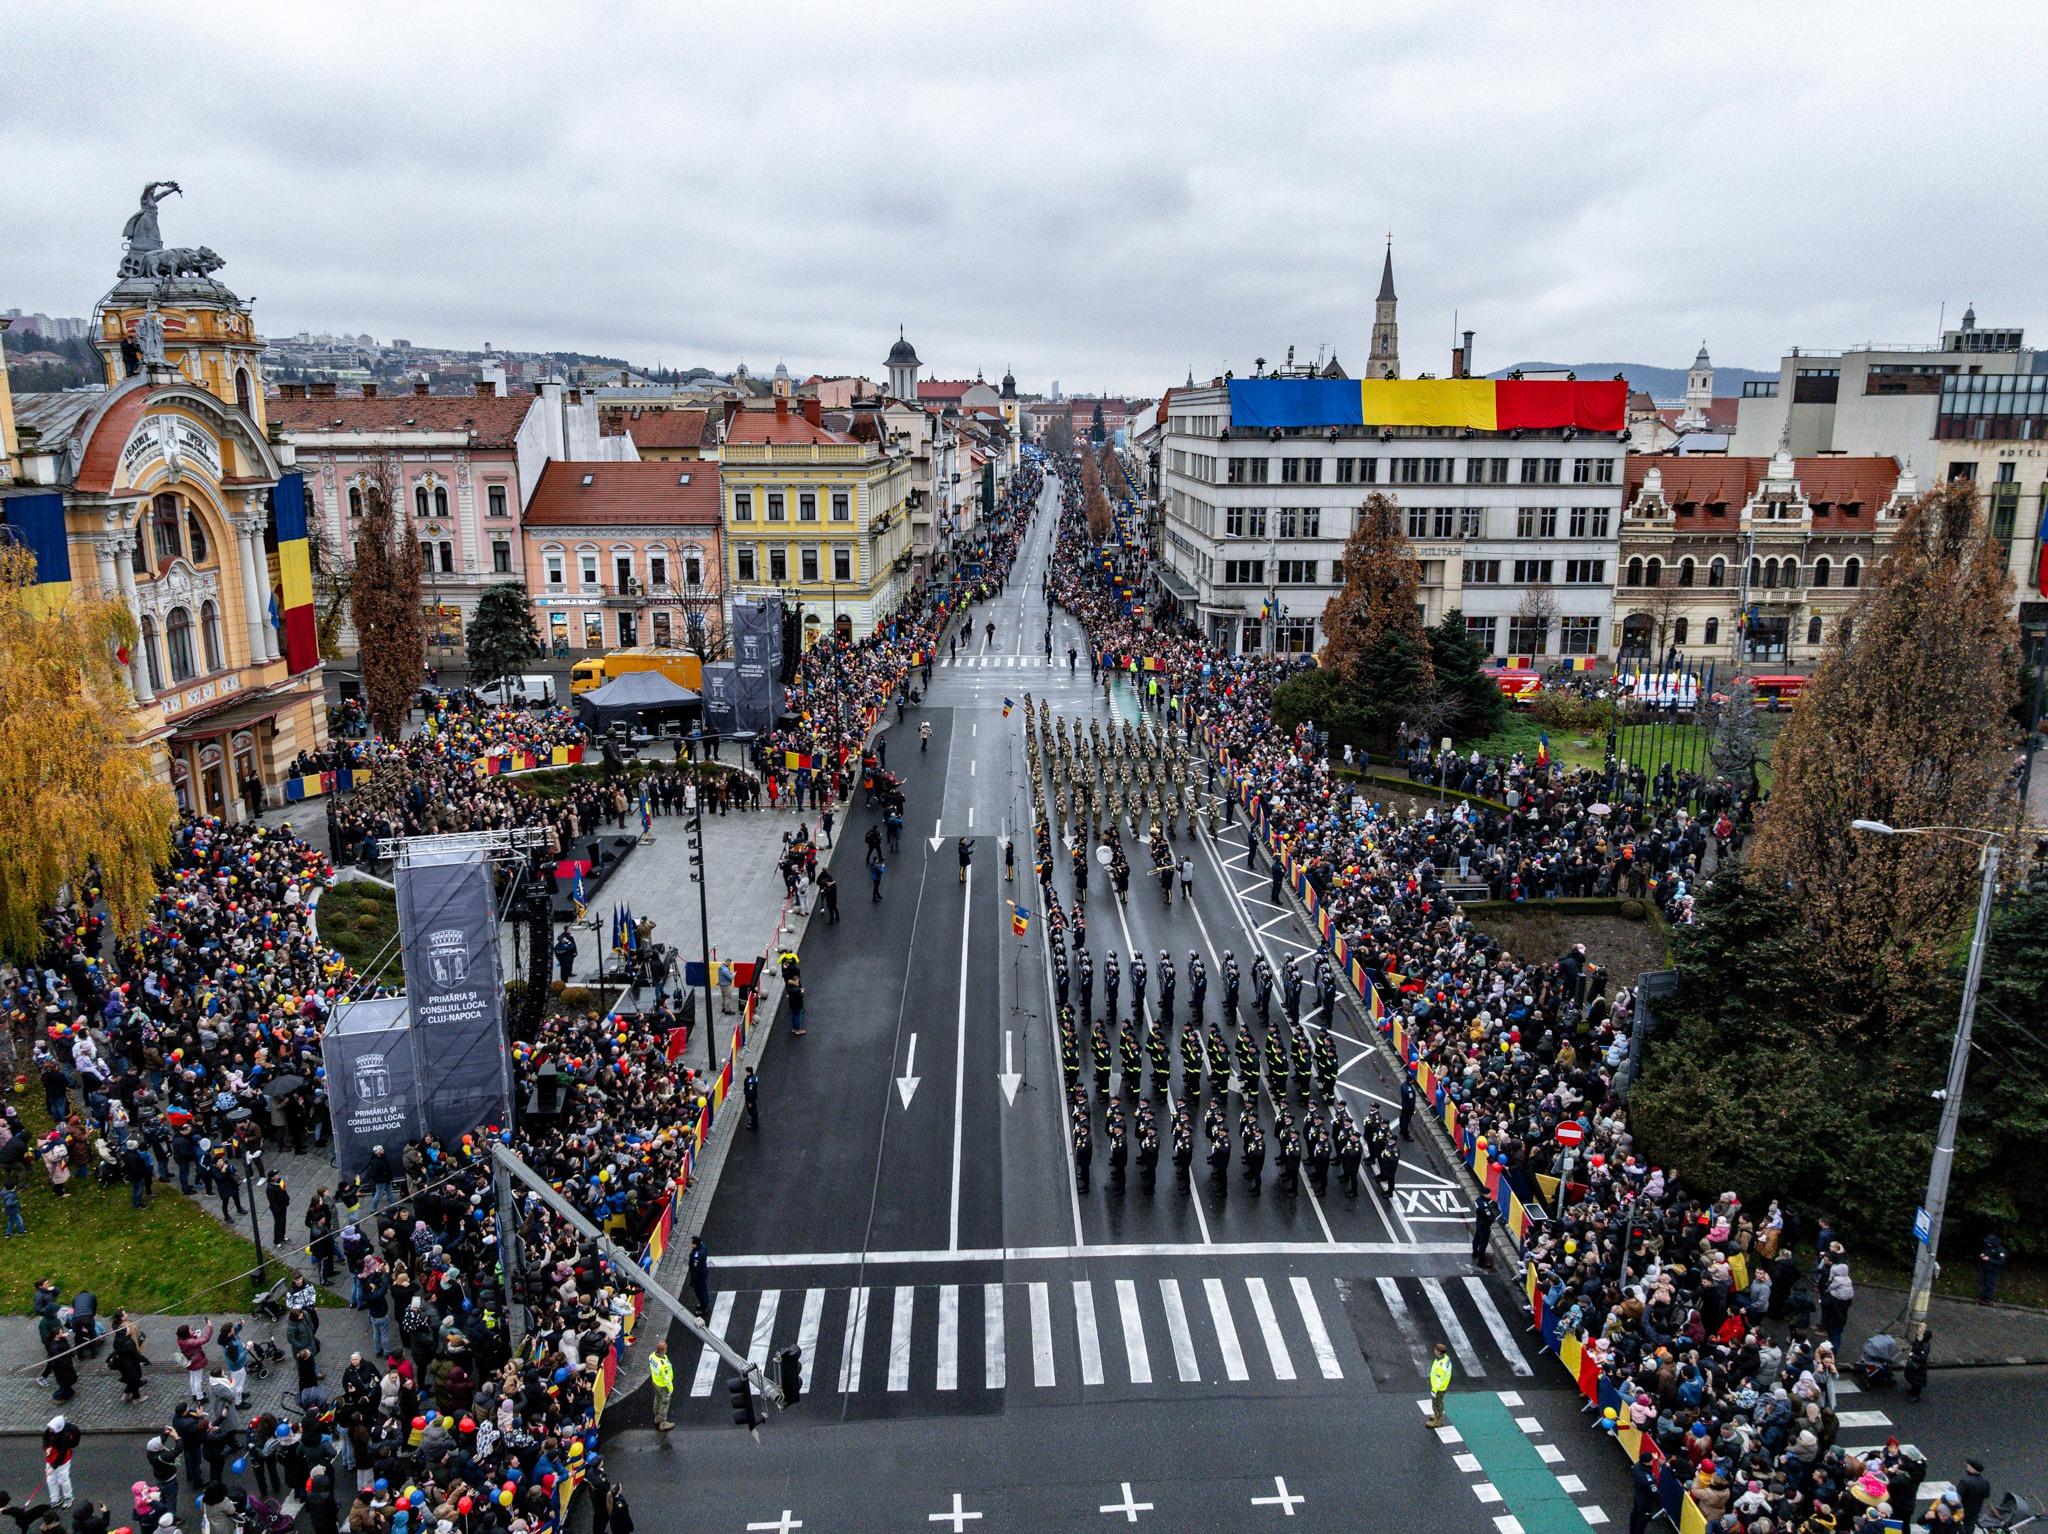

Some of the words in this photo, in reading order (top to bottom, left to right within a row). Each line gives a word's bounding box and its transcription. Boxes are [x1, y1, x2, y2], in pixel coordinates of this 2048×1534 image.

[429, 992, 467, 1004] PRIMĂRIA
[420, 1003, 461, 1015] CONSILIUL
[462, 1000, 488, 1010] LOCAL
[428, 1010, 482, 1024] CLUJ-NAPOCA
[347, 1116, 384, 1126] CONSILIUL
[384, 1112, 406, 1122] LOCAL
[355, 1107, 388, 1117] PRIMĂRIA
[354, 1121, 401, 1134] CLUJ-NAPOCA
[1393, 1190, 1471, 1213] TAXI
